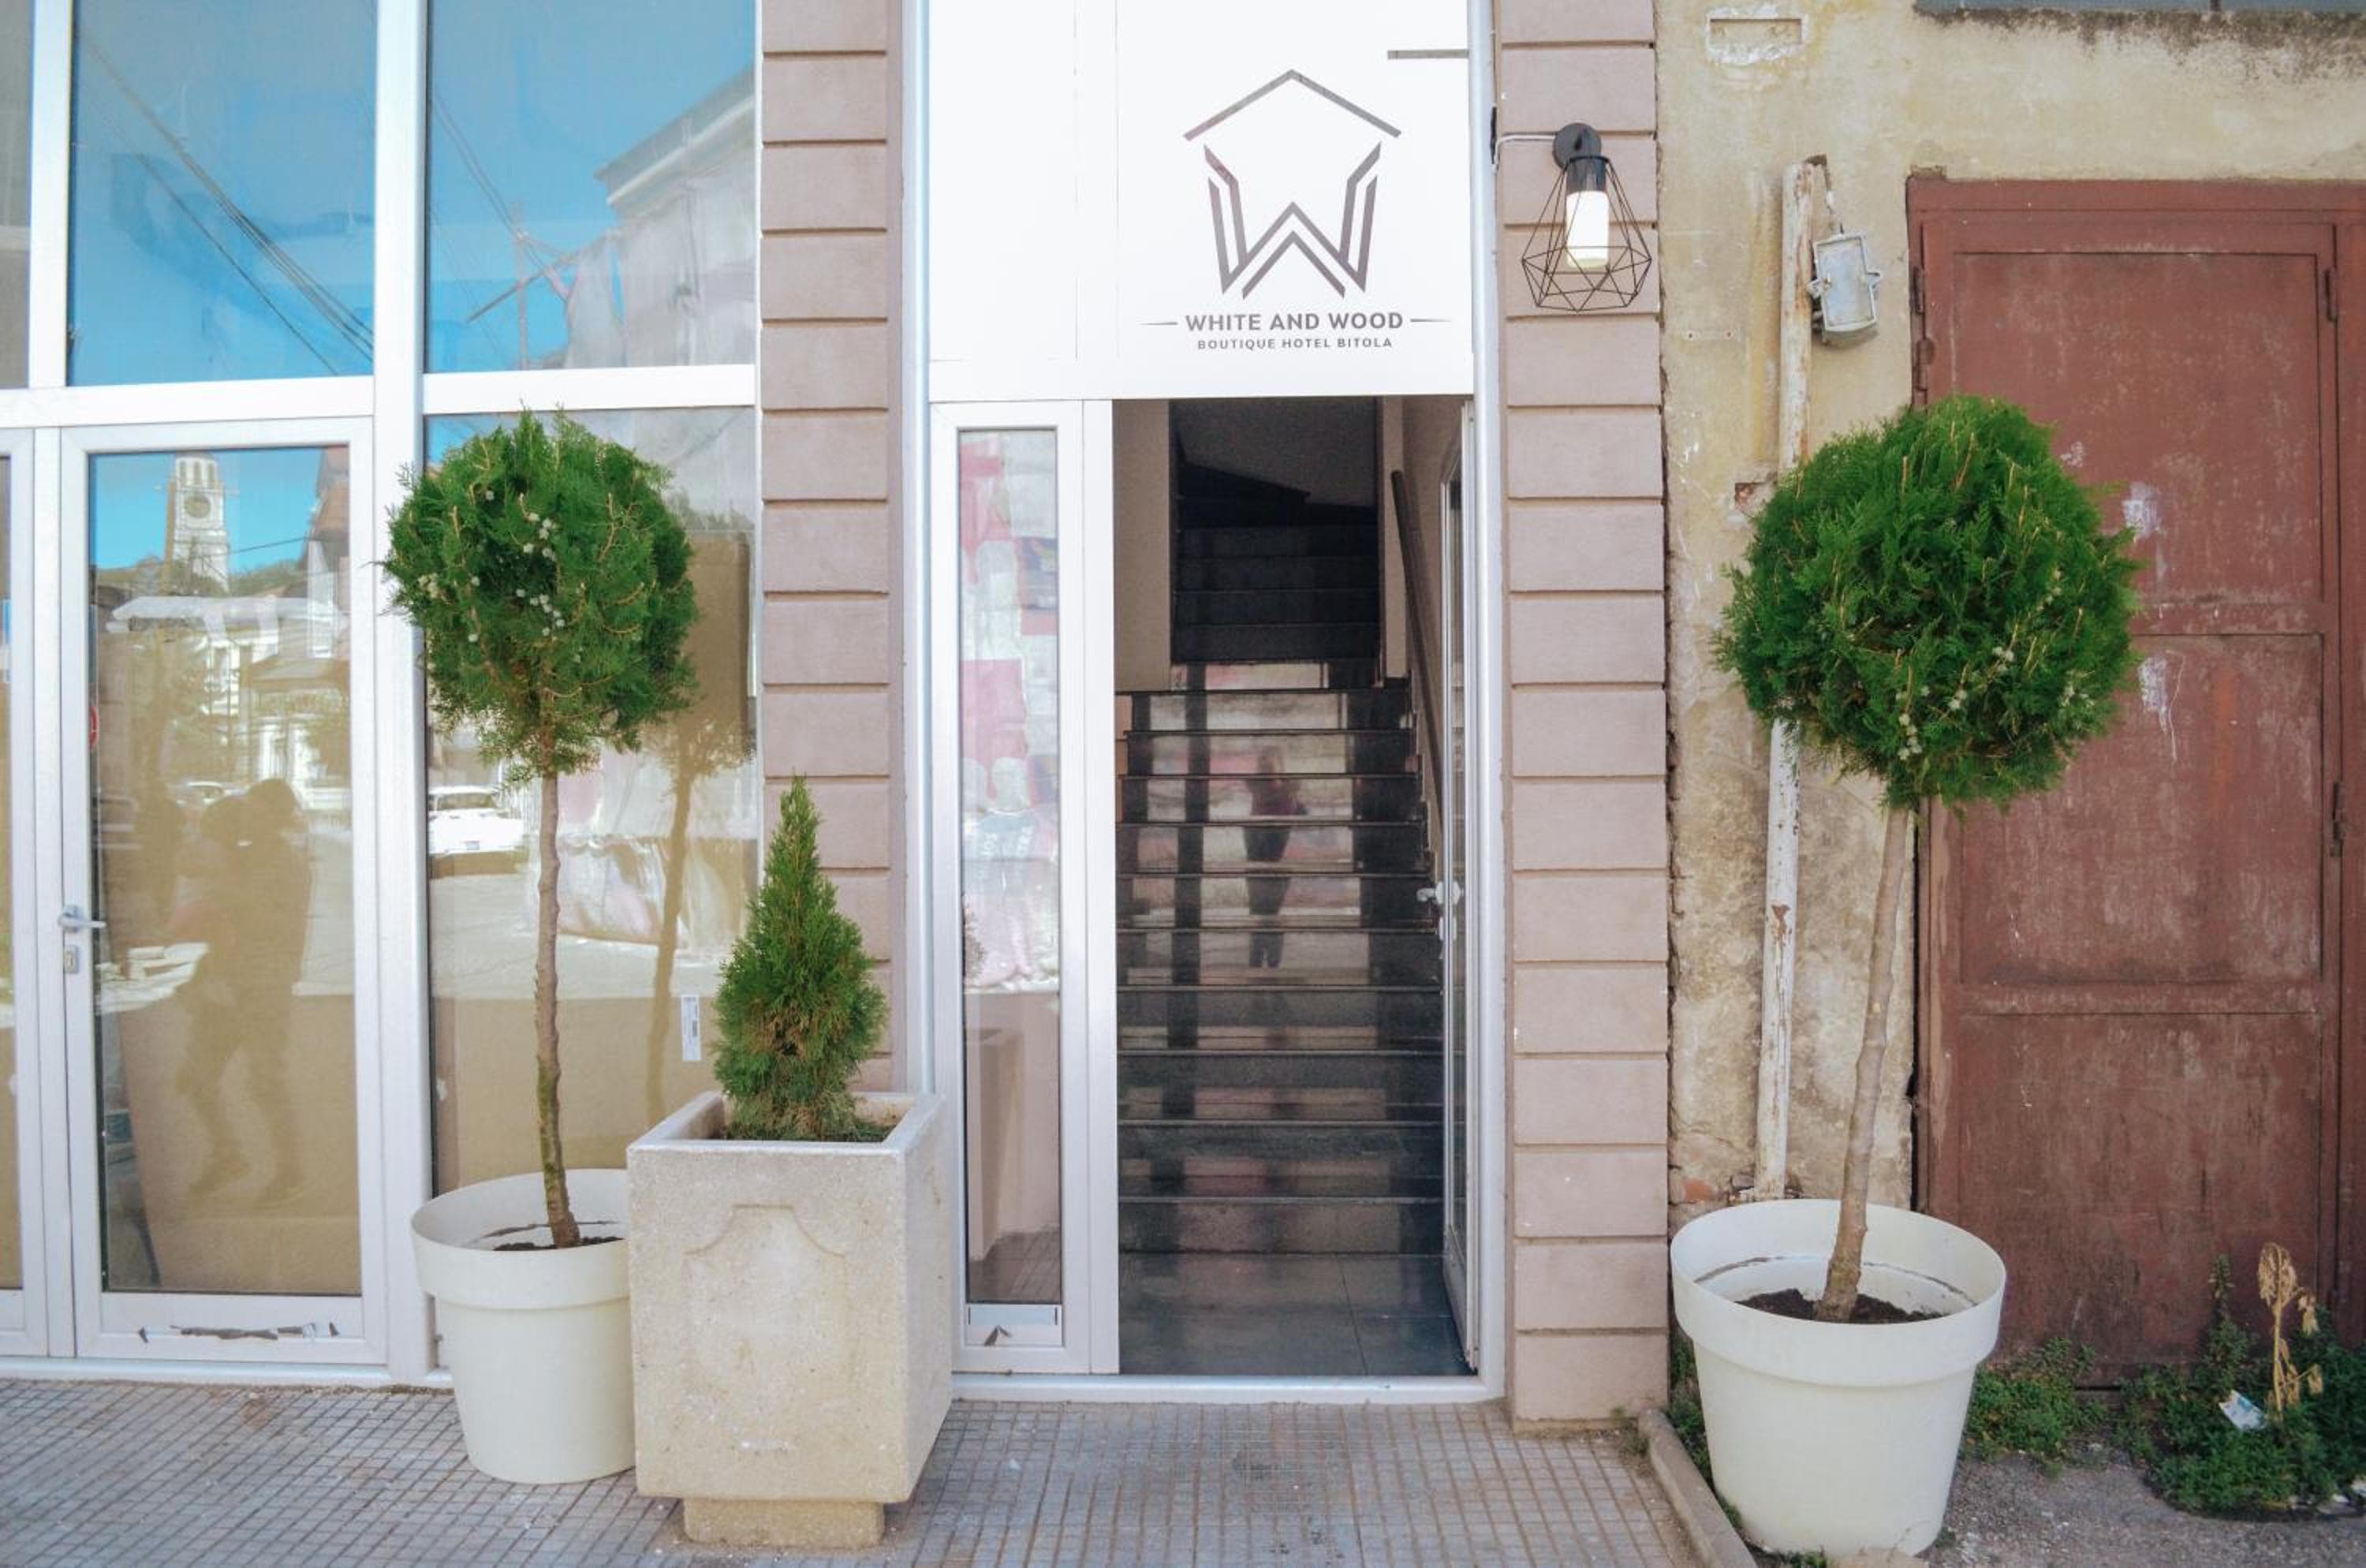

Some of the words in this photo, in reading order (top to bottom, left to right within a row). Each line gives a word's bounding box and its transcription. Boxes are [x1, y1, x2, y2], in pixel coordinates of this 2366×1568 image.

[1185, 314, 1262, 331] WHITE
[1269, 312, 1320, 330] AND
[1327, 312, 1404, 330] WOOD
[1197, 338, 1274, 351] BOUTIQUE
[1282, 338, 1331, 349] HOTEL
[1337, 337, 1392, 348] BITOLA
